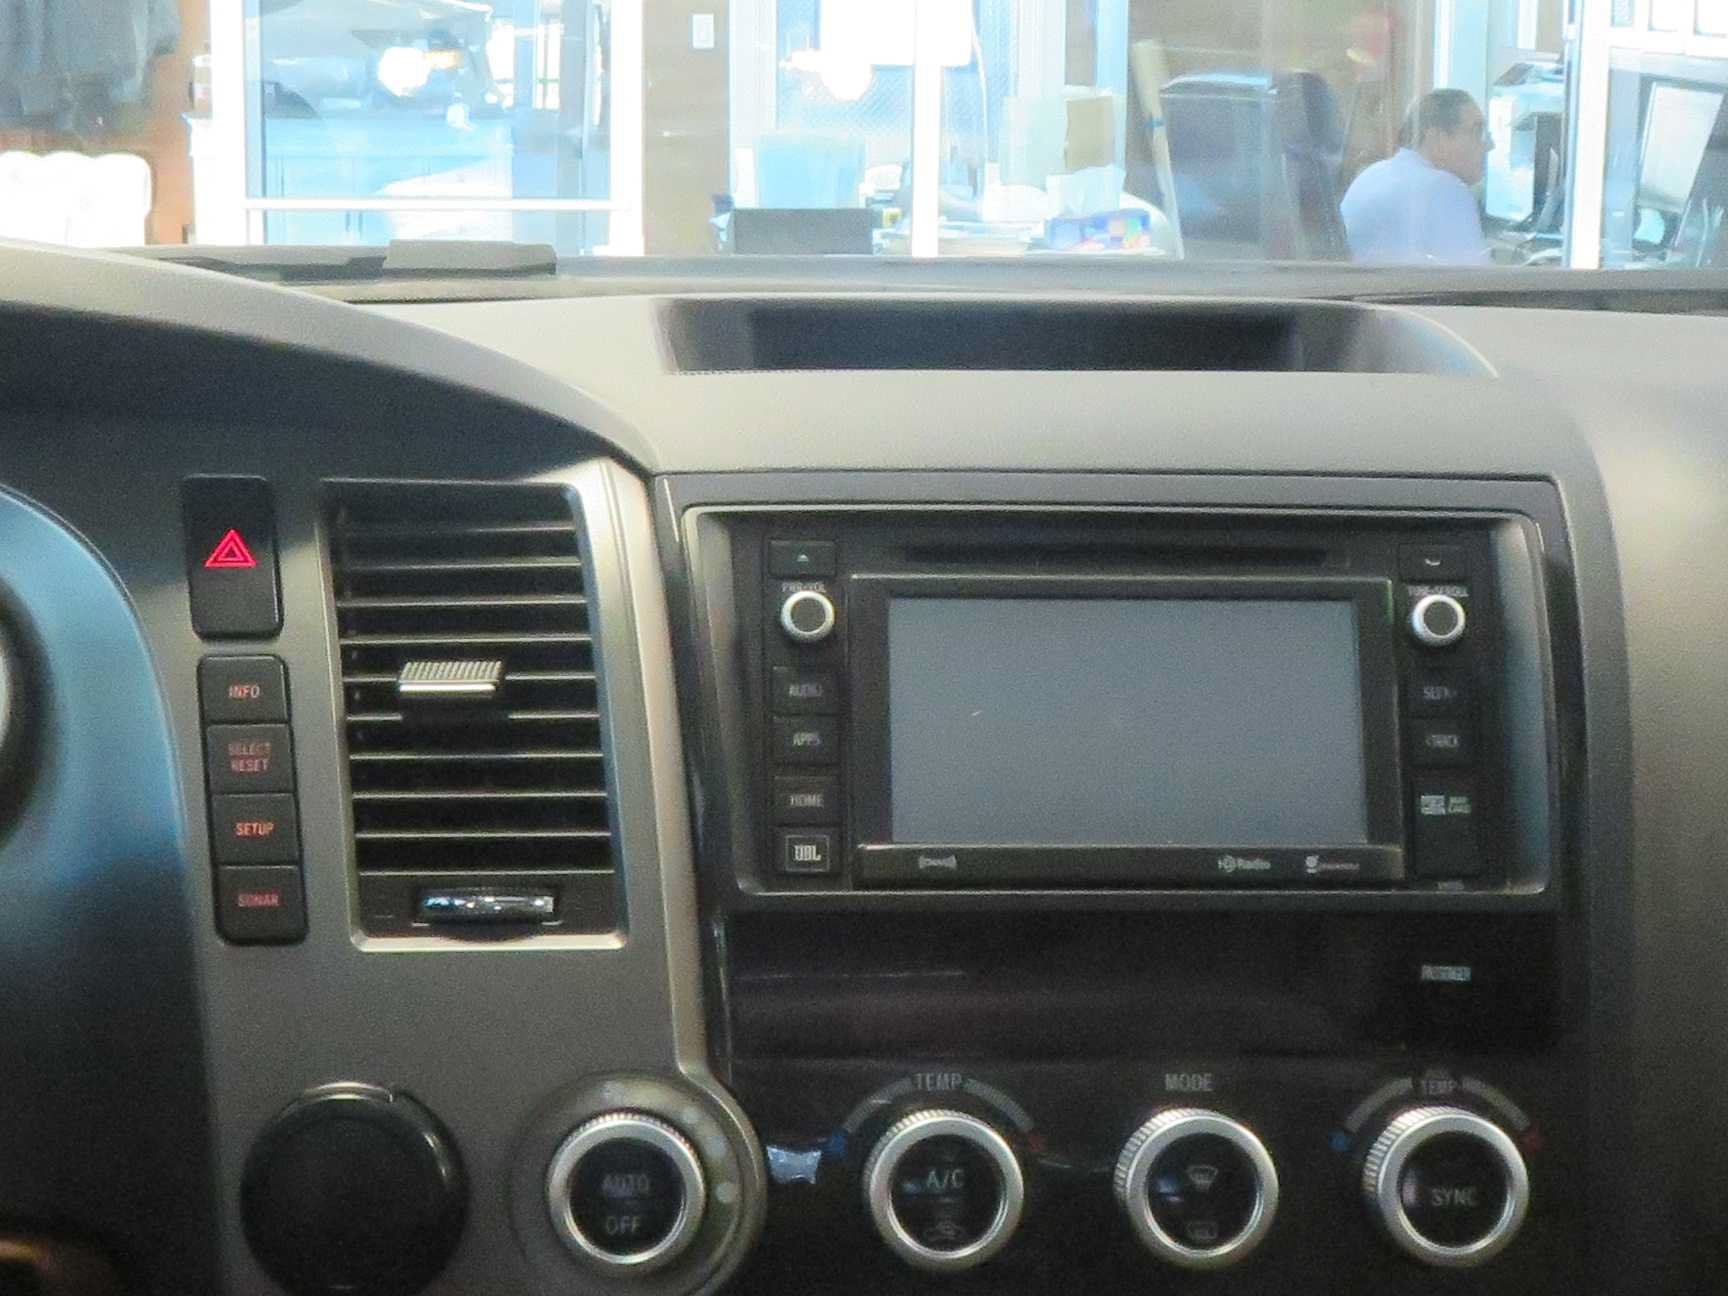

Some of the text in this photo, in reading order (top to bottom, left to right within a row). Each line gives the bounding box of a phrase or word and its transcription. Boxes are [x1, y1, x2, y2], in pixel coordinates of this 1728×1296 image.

[228, 685, 261, 699] INFO
[788, 684, 824, 697] AUDIO
[792, 732, 821, 746] APPS
[228, 742, 272, 756] SELECT
[230, 758, 270, 773] RESET
[789, 794, 825, 808] HOME
[235, 821, 275, 836] SETUP
[794, 845, 822, 861] JBL
[237, 893, 280, 907] SONAR
[913, 1072, 963, 1091] TEMP
[1164, 1072, 1214, 1092] MODE
[601, 1173, 651, 1195] AUTO
[926, 1167, 964, 1190] A/C
[1431, 1187, 1480, 1208] SYNC
[605, 1215, 642, 1234] OFF
